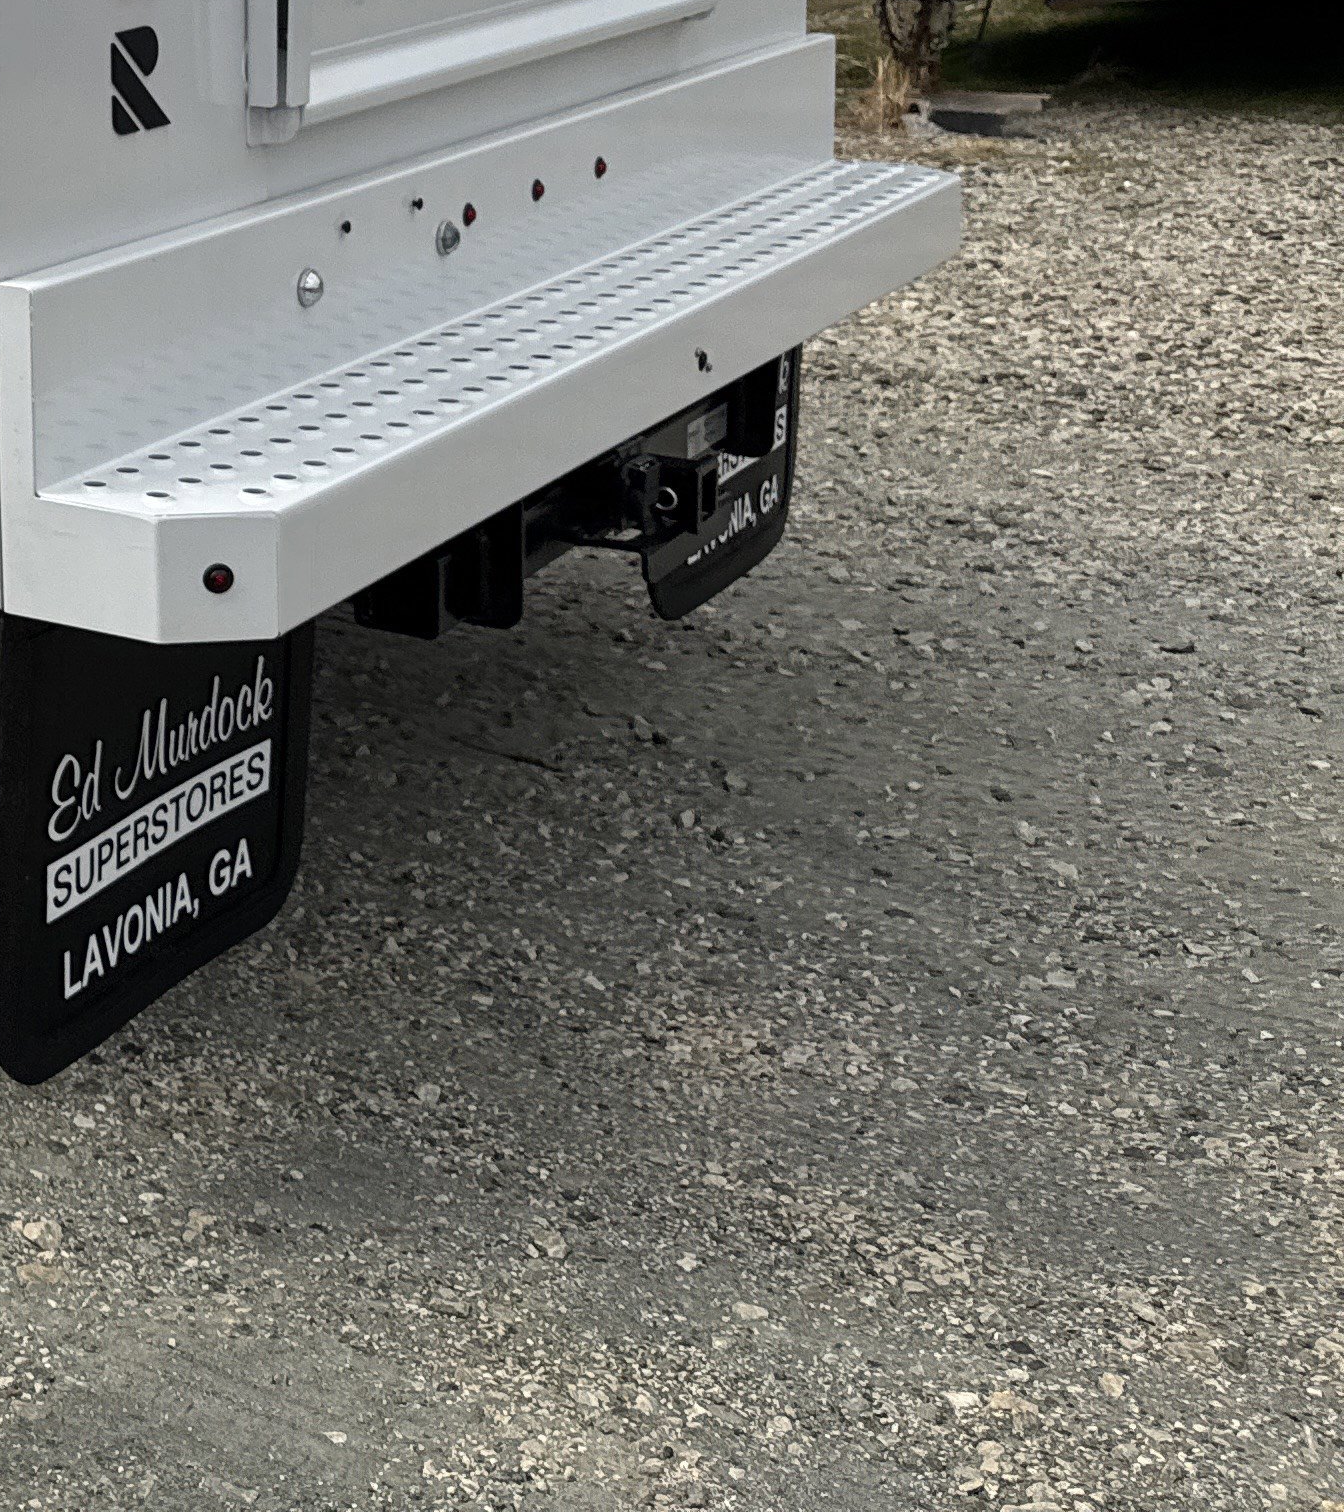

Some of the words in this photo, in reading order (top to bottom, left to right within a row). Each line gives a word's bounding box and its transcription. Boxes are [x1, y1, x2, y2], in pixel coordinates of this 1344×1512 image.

[760, 473, 780, 515] GA
[47, 739, 103, 843] Ed
[113, 654, 274, 801] Murdock
[51, 748, 267, 909] SUPERSTORES
[63, 871, 200, 1001] LAVONIA,
[208, 837, 253, 896] GA
